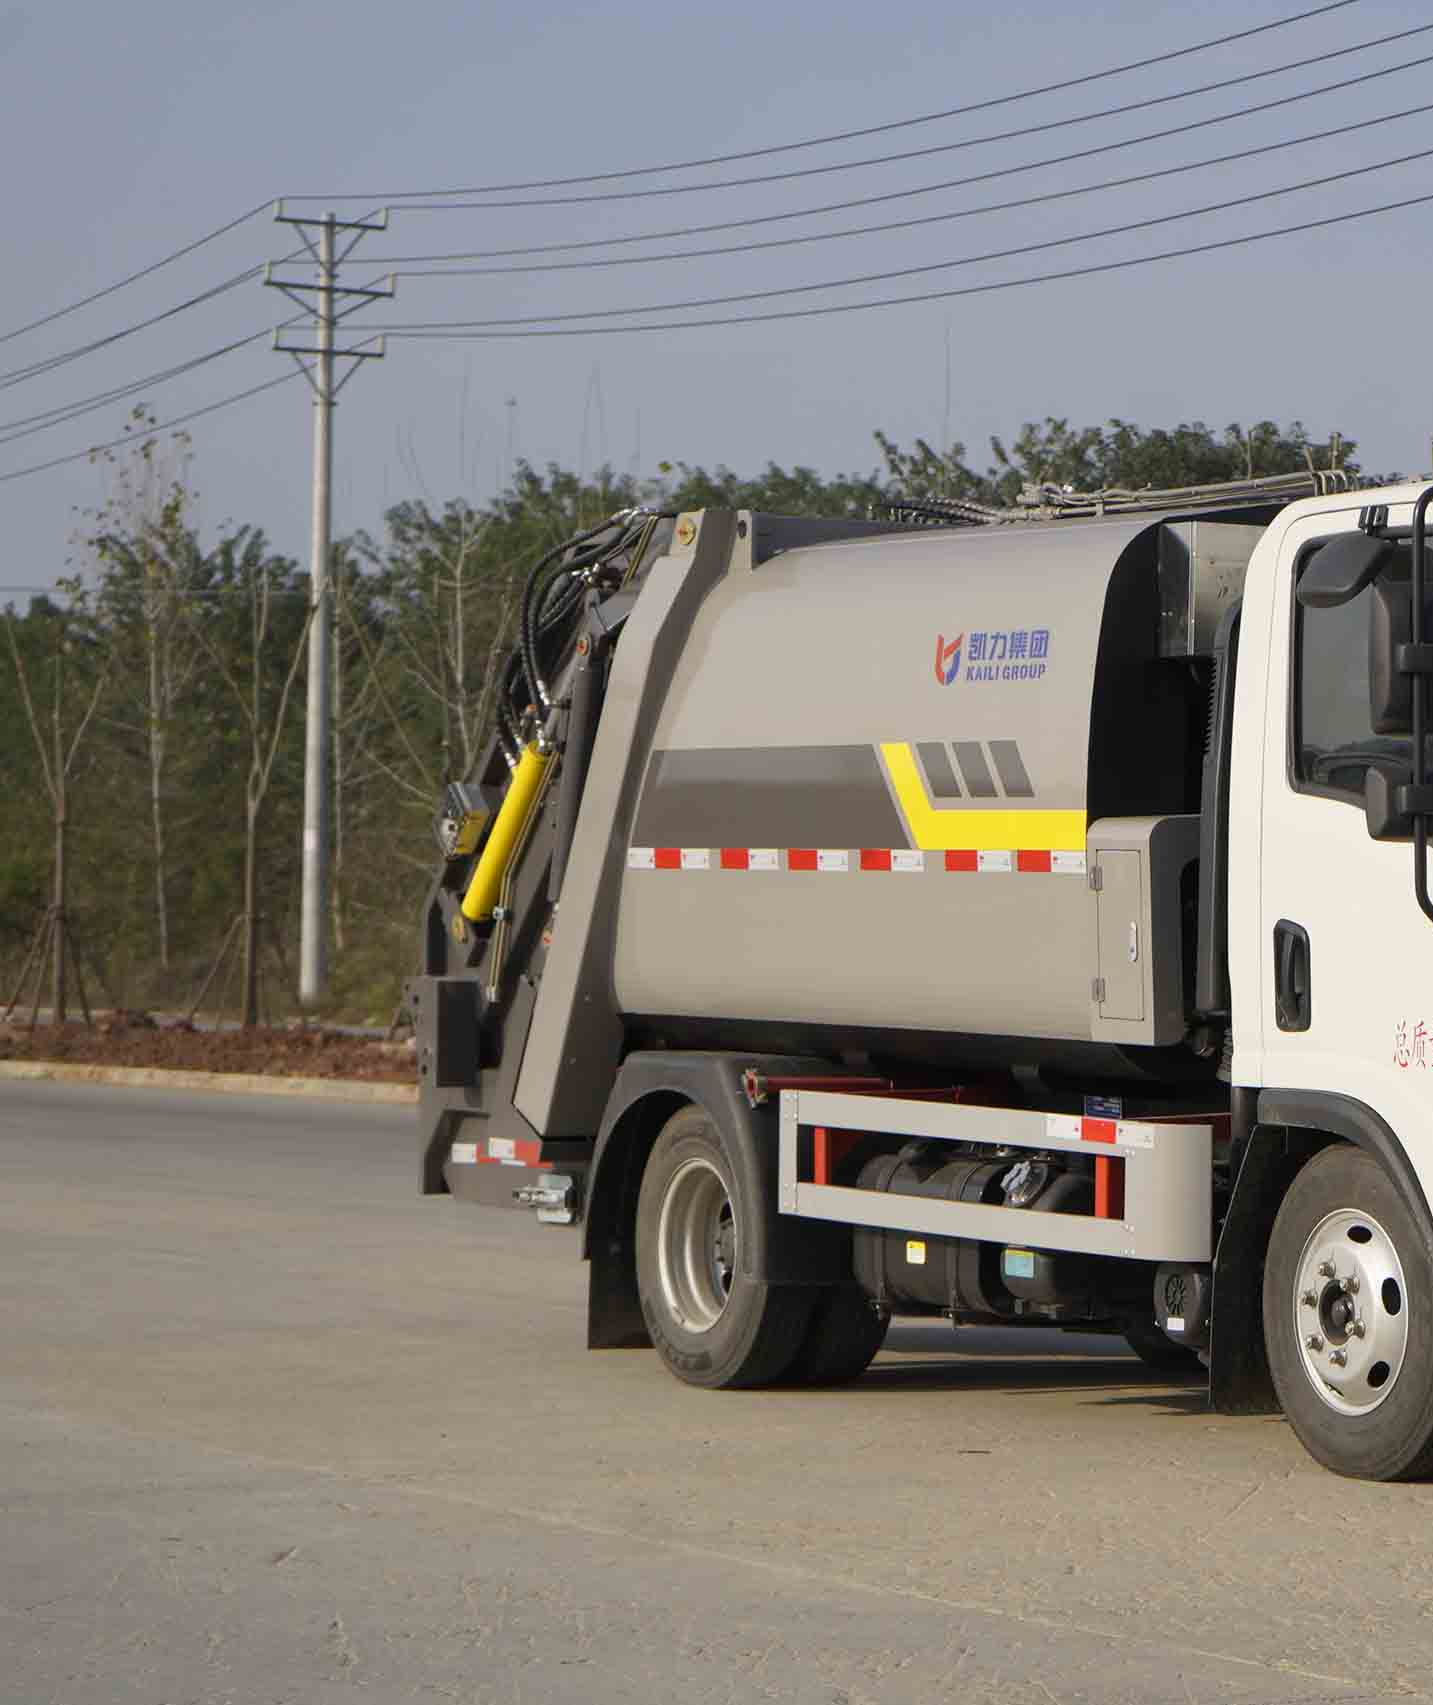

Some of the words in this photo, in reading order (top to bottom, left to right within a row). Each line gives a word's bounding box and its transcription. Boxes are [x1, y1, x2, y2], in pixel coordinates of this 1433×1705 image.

[967, 629, 1050, 662] 凯力集团
[966, 665, 999, 682] KAILI
[1002, 663, 1046, 680] GROUP
